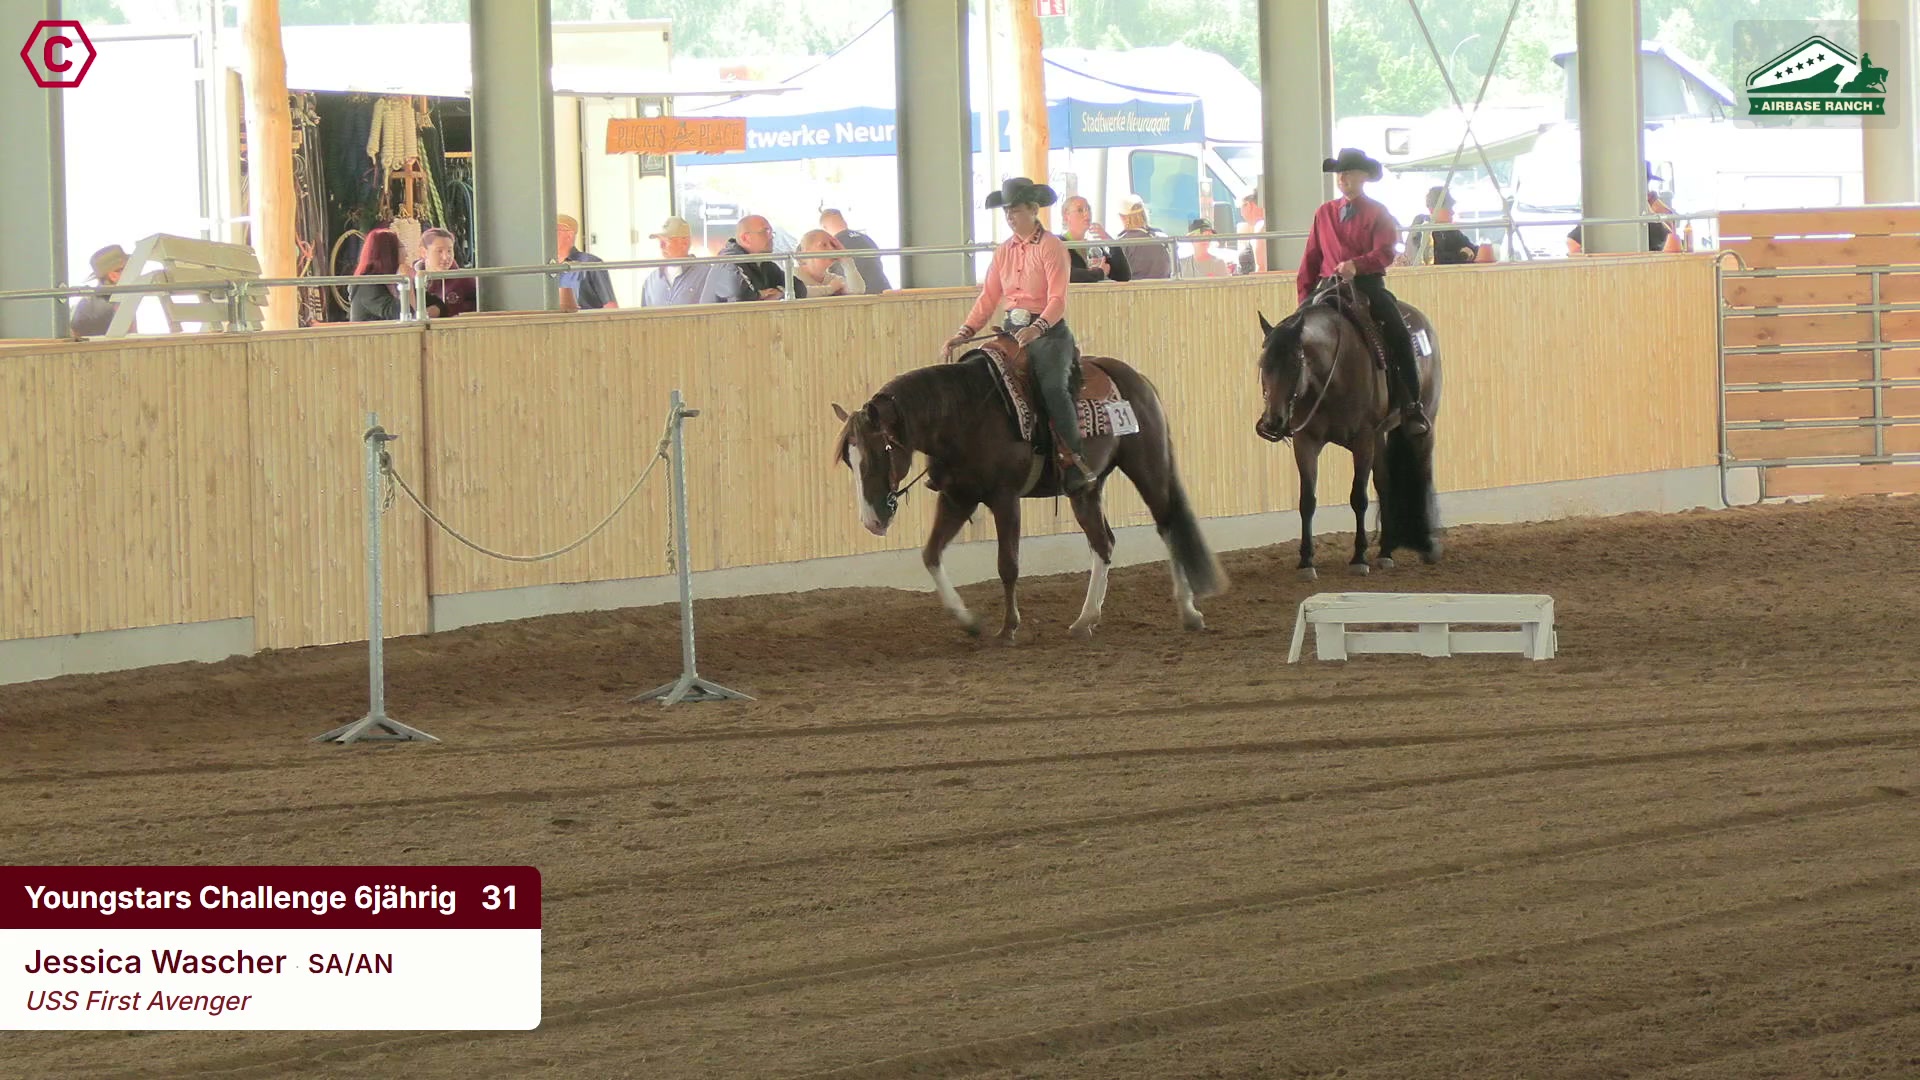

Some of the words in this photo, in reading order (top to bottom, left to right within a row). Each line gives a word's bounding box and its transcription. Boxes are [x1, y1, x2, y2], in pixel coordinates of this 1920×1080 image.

[1082, 110, 1126, 133] Stadtwerke
[699, 122, 740, 147] PLACE
[746, 124, 832, 149] twerke
[834, 121, 896, 144] Neur
[1113, 407, 1132, 427] 31
